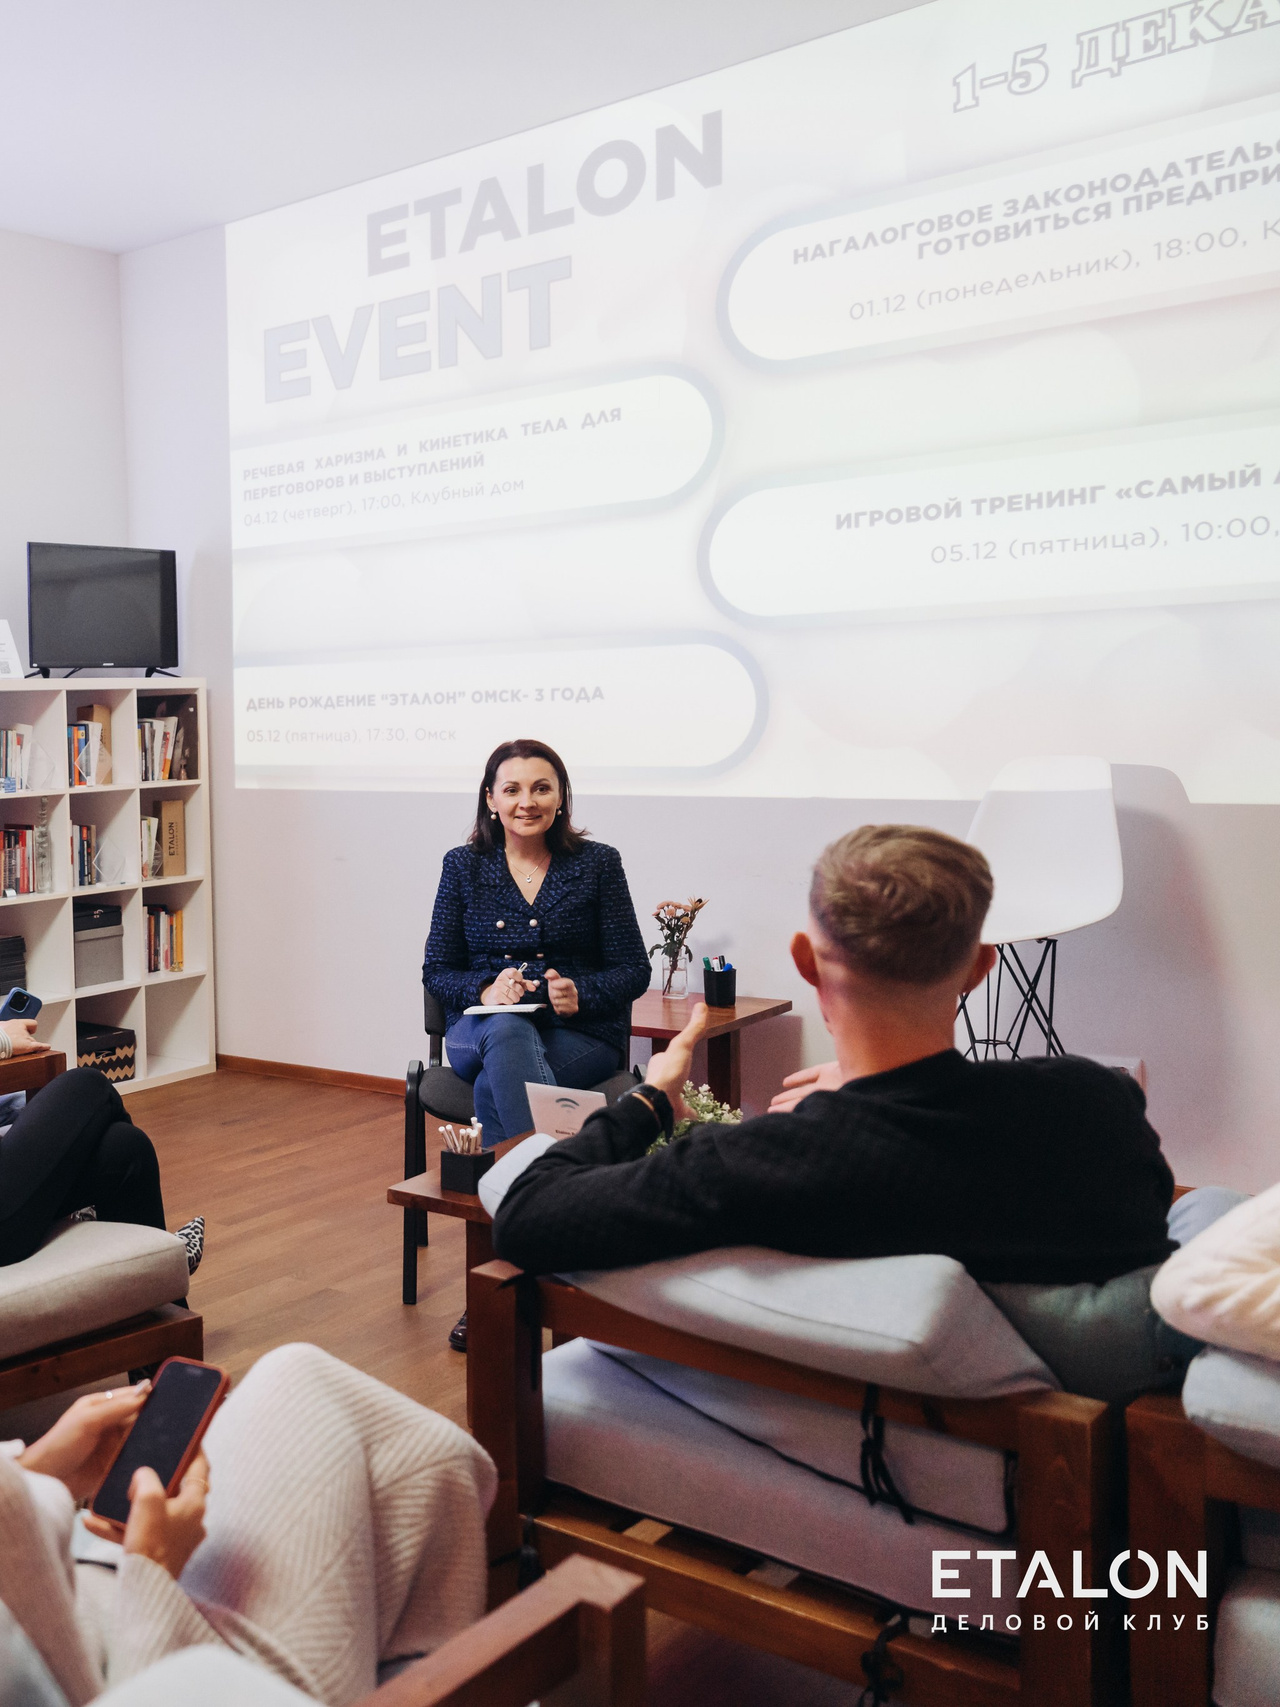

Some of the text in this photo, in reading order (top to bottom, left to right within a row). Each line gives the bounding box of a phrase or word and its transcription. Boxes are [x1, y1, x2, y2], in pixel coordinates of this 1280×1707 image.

[366, 109, 723, 278] ETALON
[792, 138, 1280, 265] НАГАЛОГОВОЕ ЗАКОНОДАТЕЛЬ
[917, 162, 1280, 261] ГОТОВИТЬСЯ ПРЕДПРИ
[848, 293, 907, 321] 01.12
[915, 248, 1141, 310] (понедельник),
[1152, 226, 1248, 261] 18:00,
[262, 255, 573, 404] EVENT
[242, 406, 623, 482] РЕЧЕВАЯ ХАРИЗМА И КИНЕТИКА ТЕЛА ДЛЯ
[242, 450, 486, 502] ПЕРЕГОВОРОВ И ВЫСТУПЛЕНИЙ
[243, 478, 525, 528] 04.12 (четверг), 17:00, Клубный дом
[834, 496, 963, 531] ИГРОВОЙ
[970, 484, 1107, 517] ТРЕНИНГ
[1114, 462, 1262, 501] «САМЫЙ
[929, 515, 1280, 564] 05.12 (пятница), 10:00,
[245, 697, 286, 712] ДЕНЬ
[288, 694, 377, 710] РОЖДЕНИЕ
[470, 688, 529, 705] ОМСК-
[534, 687, 545, 702] 3
[549, 685, 606, 704] ГОДА
[245, 728, 281, 743] 05.12
[284, 728, 362, 744] (пятница),
[366, 727, 409, 744] 17:30,
